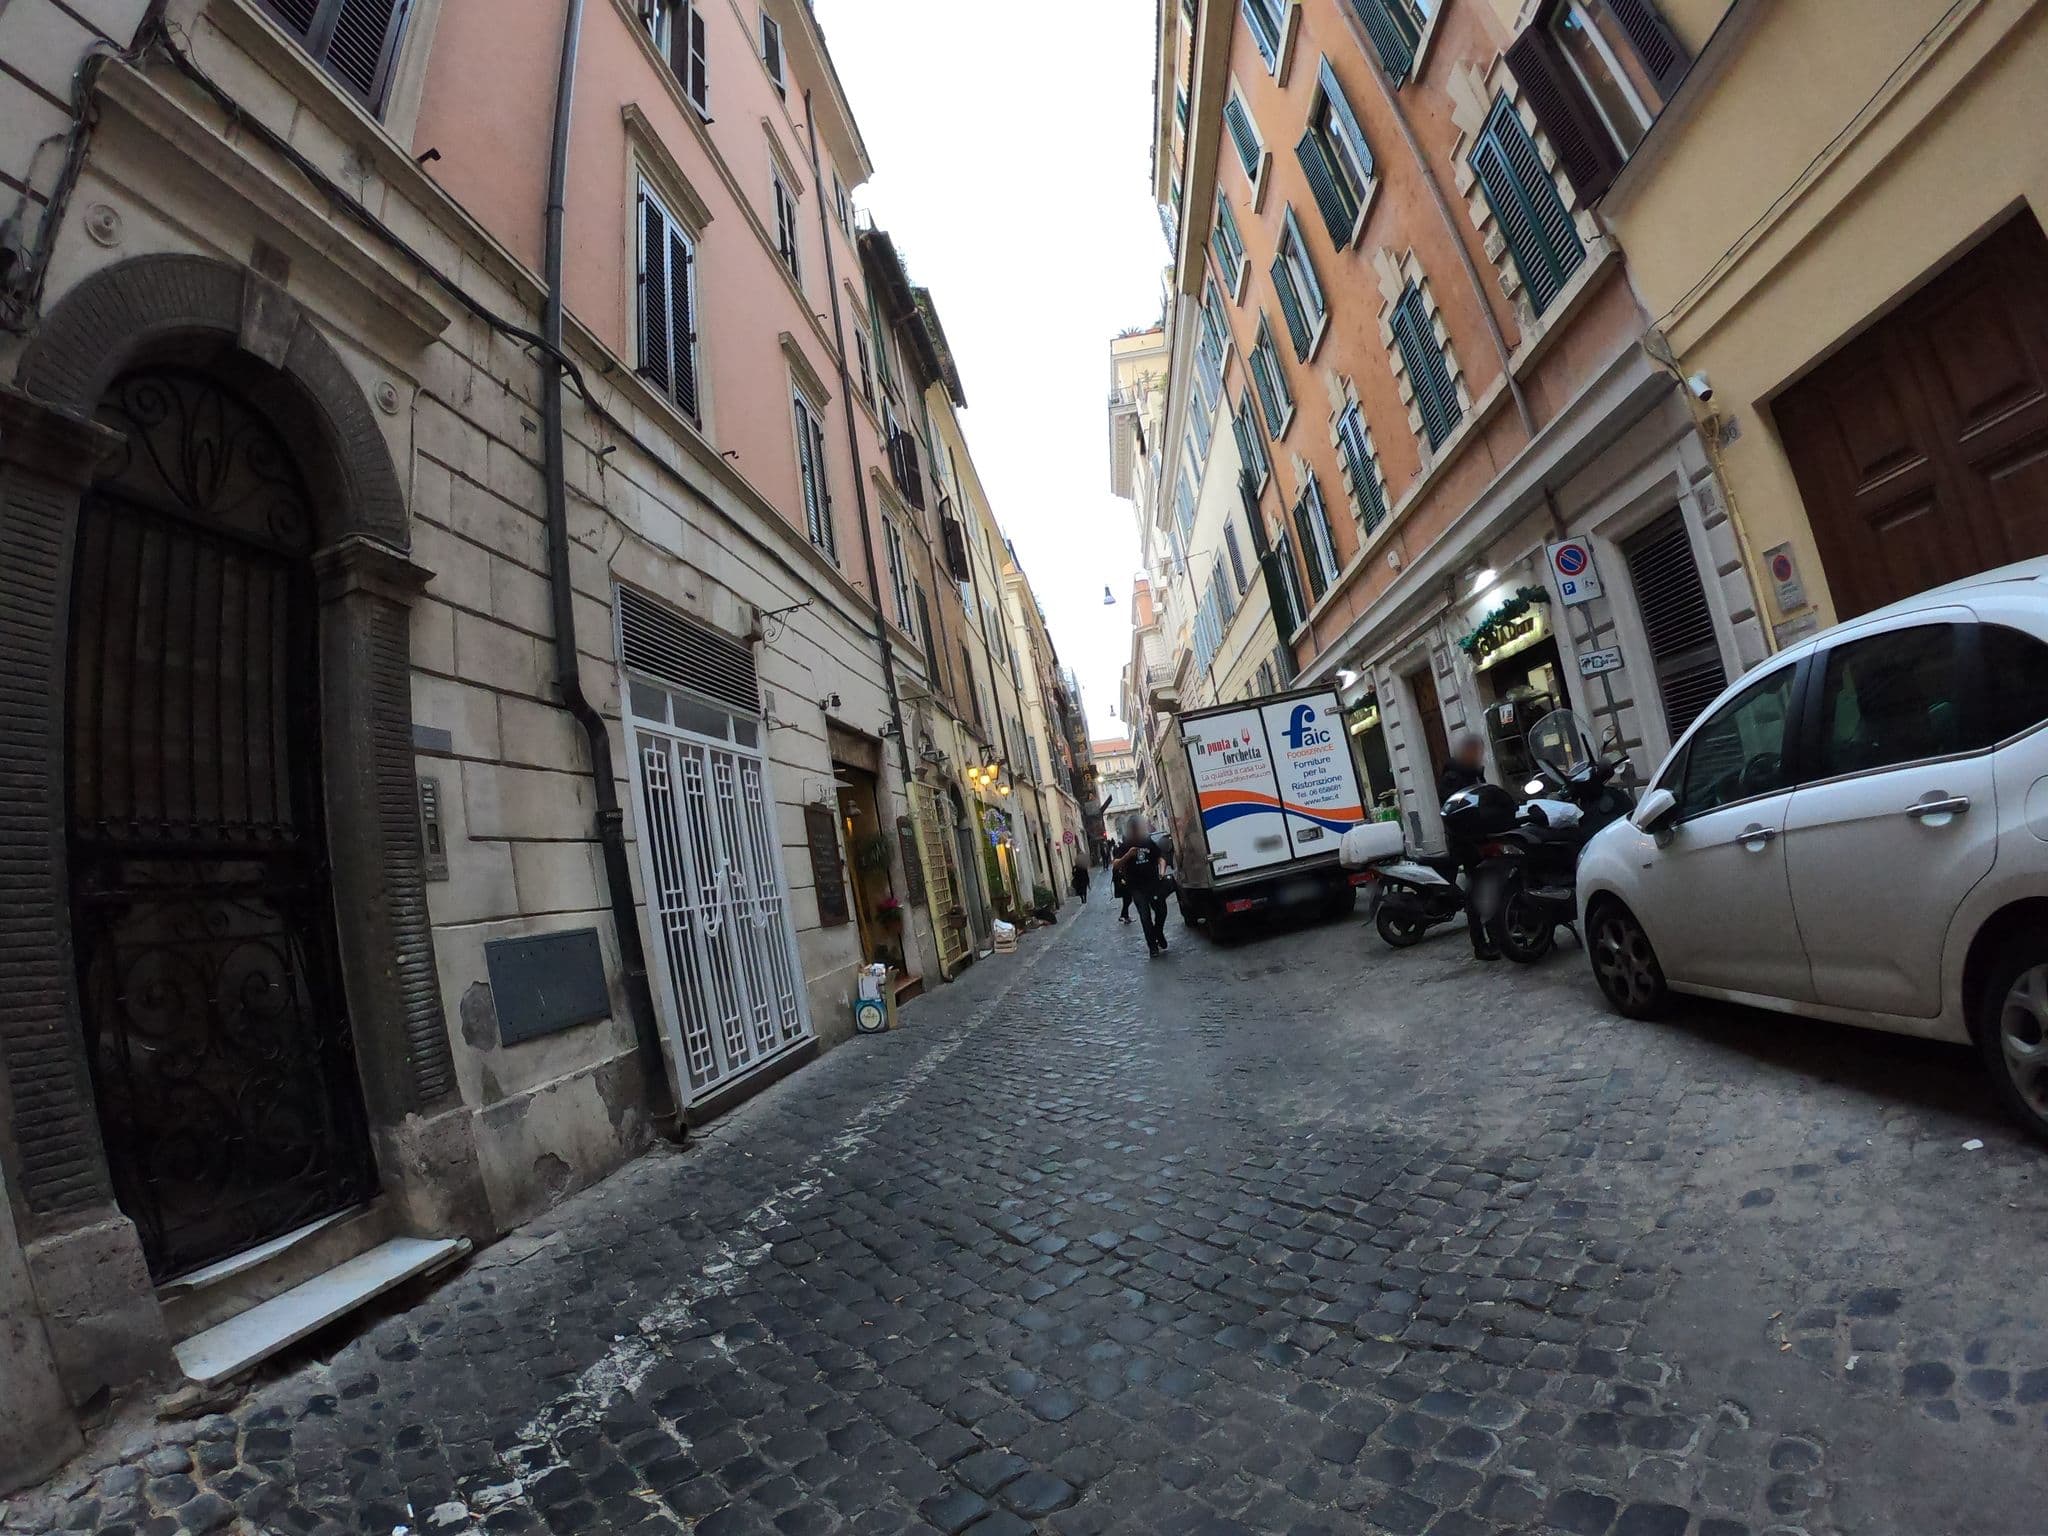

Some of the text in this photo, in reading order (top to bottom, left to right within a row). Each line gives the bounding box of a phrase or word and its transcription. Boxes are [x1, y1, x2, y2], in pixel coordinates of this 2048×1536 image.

[1564, 583, 1573, 594] P
[1281, 704, 1331, 749] faic
[1207, 739, 1231, 756] punta
[1222, 747, 1261, 765] forchetta
[1293, 756, 1331, 769] Forniture
[1303, 766, 1327, 779] per la
[1291, 775, 1343, 791] Ristorazione
